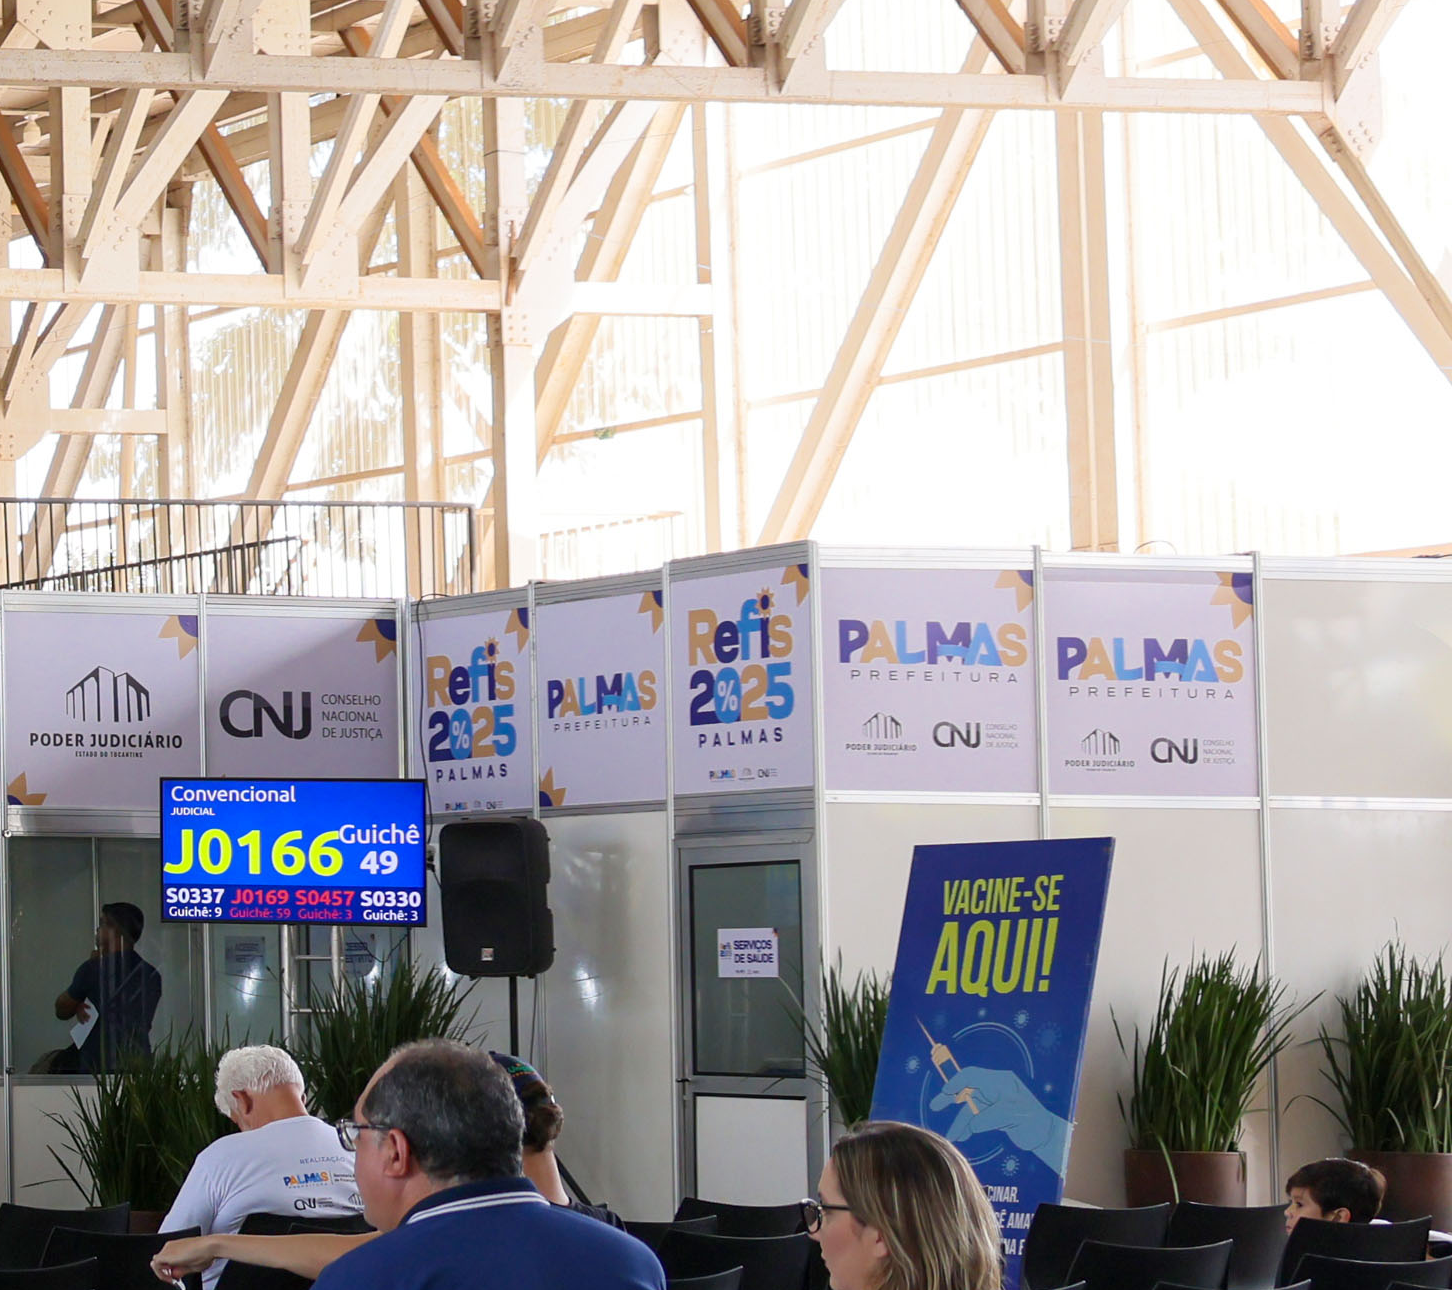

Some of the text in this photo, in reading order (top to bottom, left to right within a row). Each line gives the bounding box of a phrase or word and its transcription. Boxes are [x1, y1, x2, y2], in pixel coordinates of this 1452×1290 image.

[688, 586, 793, 666] Refis
[839, 620, 1027, 667] PALMAS
[1057, 637, 1243, 683] PALMAS
[427, 637, 515, 708] Refis
[851, 670, 1017, 683] PREFEITURA
[322, 694, 380, 705] CONSELHO
[548, 670, 657, 718] PALMAS
[1070, 686, 1233, 699] PREFEITURA
[220, 690, 311, 739] CNJ
[322, 711, 379, 722] NACIONAL
[554, 717, 651, 731] PREFEITURA
[30, 731, 182, 748] PODER JUDICIÁRIO
[322, 728, 382, 741] DE JUSTIÇA
[699, 728, 782, 747] PALMAS
[933, 722, 980, 748] CNJ
[1151, 738, 1198, 764] CNJ
[437, 764, 507, 782] PALMAS
[171, 786, 296, 804] Convencional
[171, 807, 215, 816] JUDICIAL
[163, 823, 420, 877] J0166 Guichê
[360, 851, 398, 875] 49
[166, 888, 224, 904] S0337
[231, 889, 288, 906] J0169
[295, 889, 354, 906] S0457
[360, 891, 421, 907] S0330
[943, 875, 1064, 915] VACINE-SE
[169, 906, 222, 917] Guichê: 9
[276, 909, 291, 919] 59
[363, 909, 418, 921] Guichê: 3
[734, 940, 772, 952] SERVIÇOS
[735, 954, 744, 963] DE
[925, 918, 1058, 997] AQUI!
[283, 1171, 329, 1186] PALMAS
[988, 1186, 1019, 1202] CINAR.
